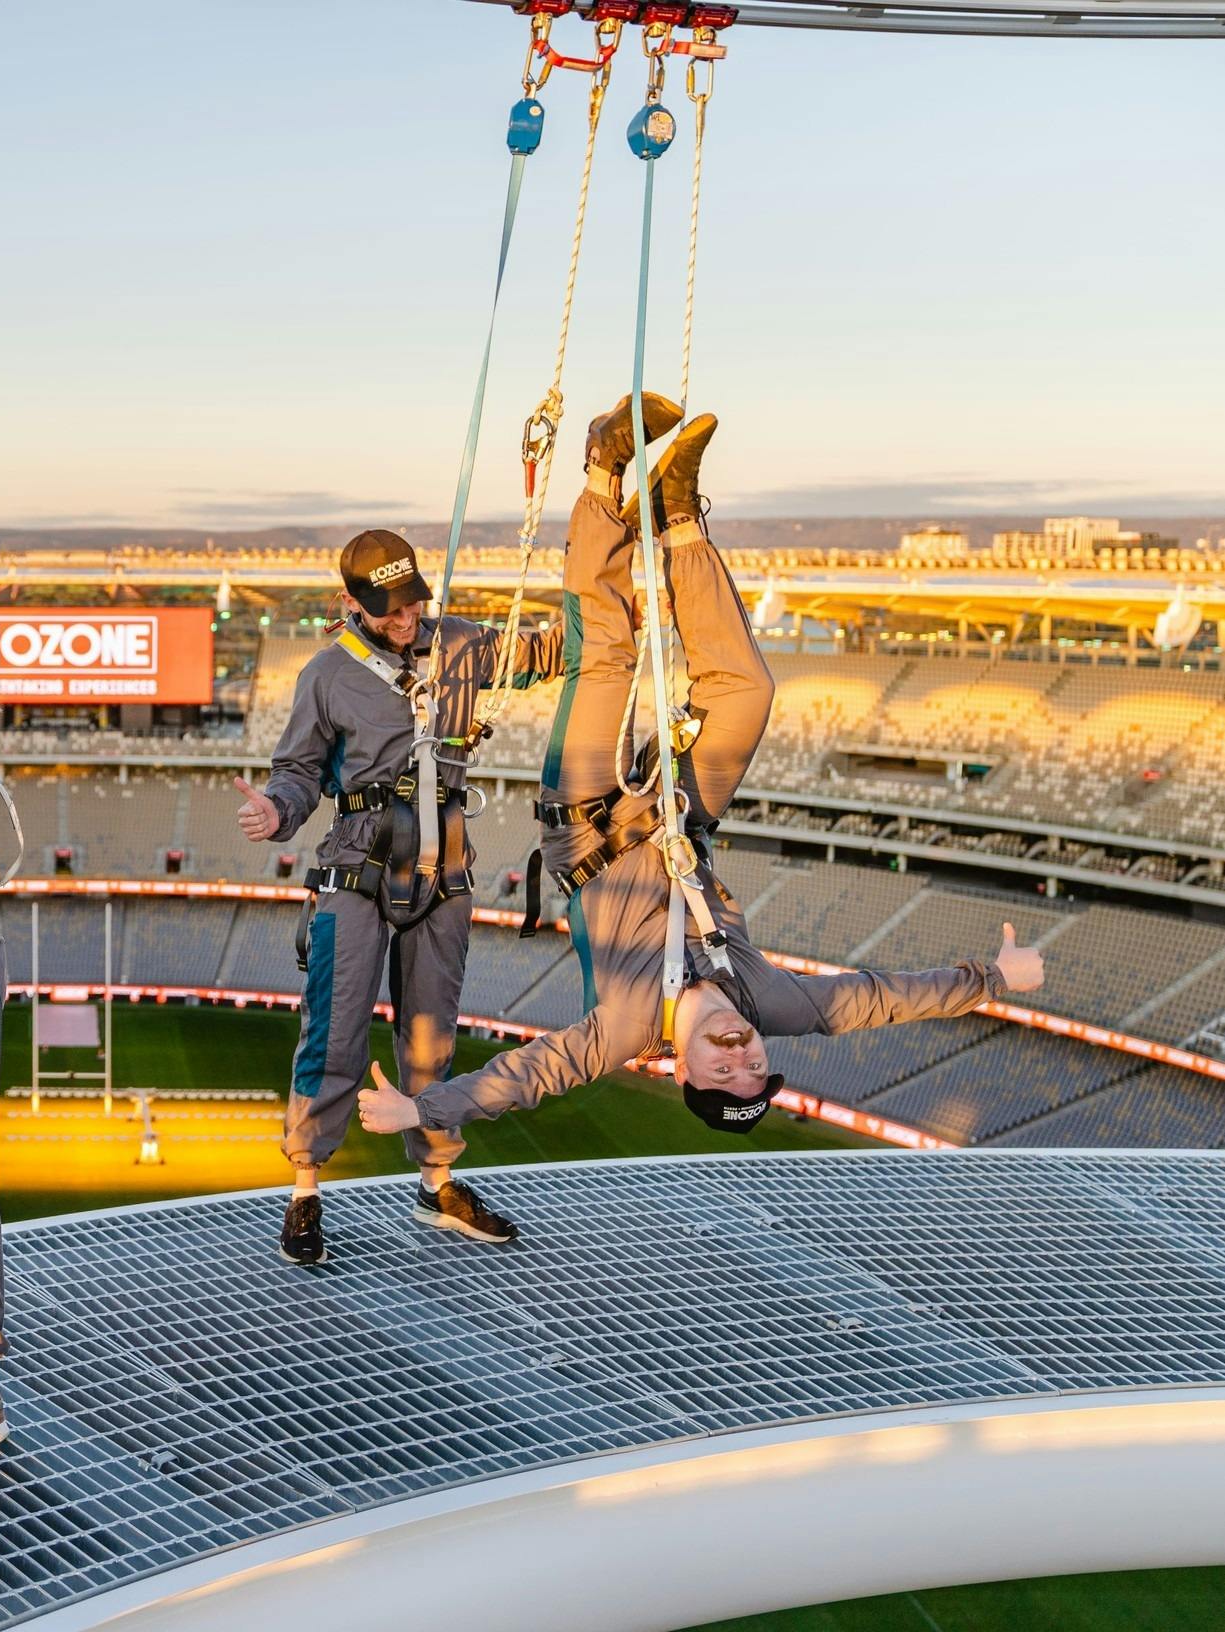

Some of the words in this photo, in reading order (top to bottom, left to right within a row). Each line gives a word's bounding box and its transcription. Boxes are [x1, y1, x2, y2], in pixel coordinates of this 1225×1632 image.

[376, 557, 413, 579] OZONE
[0, 623, 151, 667] OZONE
[723, 1105, 762, 1120] OZONE
